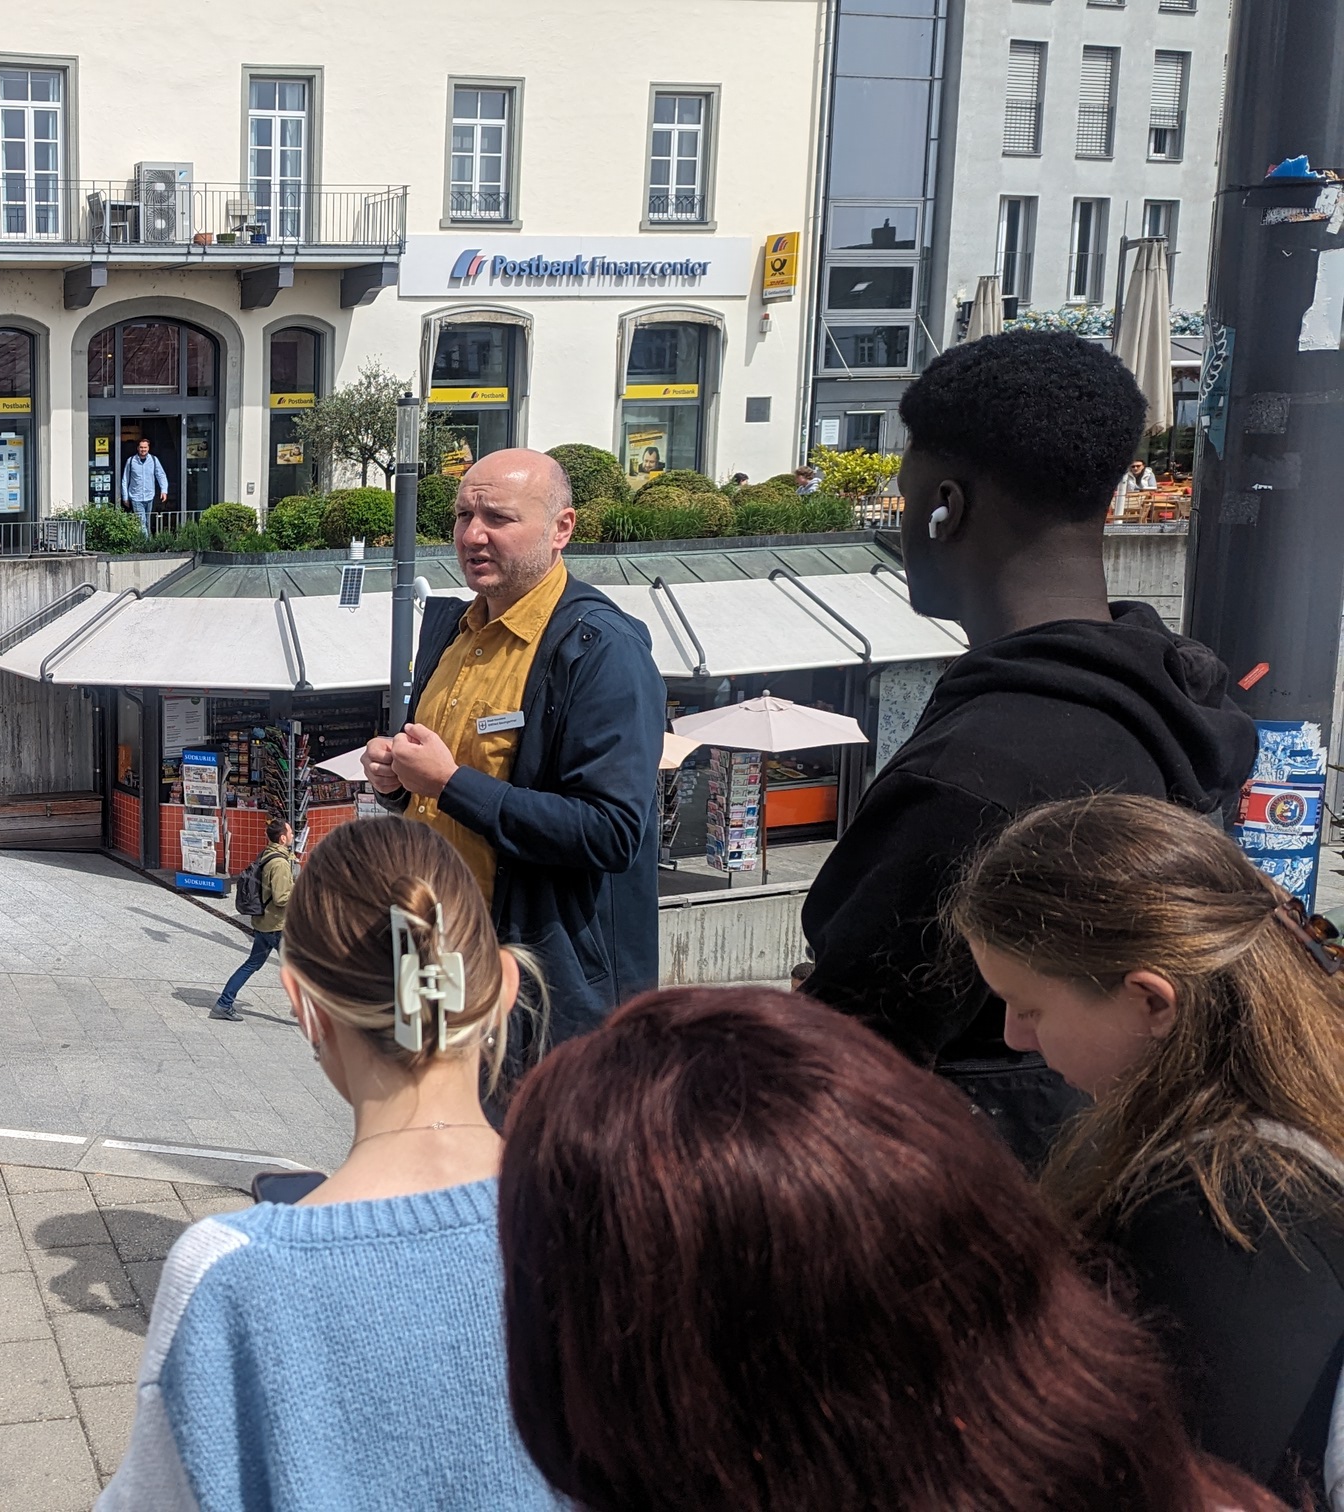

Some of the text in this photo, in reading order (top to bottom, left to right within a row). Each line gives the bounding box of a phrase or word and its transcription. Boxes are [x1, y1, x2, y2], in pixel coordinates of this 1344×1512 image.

[492, 255, 711, 276] Postbank Finanzcenter
[2, 401, 31, 409] Postbank
[184, 754, 216, 762] SÜDKURIER
[184, 878, 216, 887] SÜDKURIER
